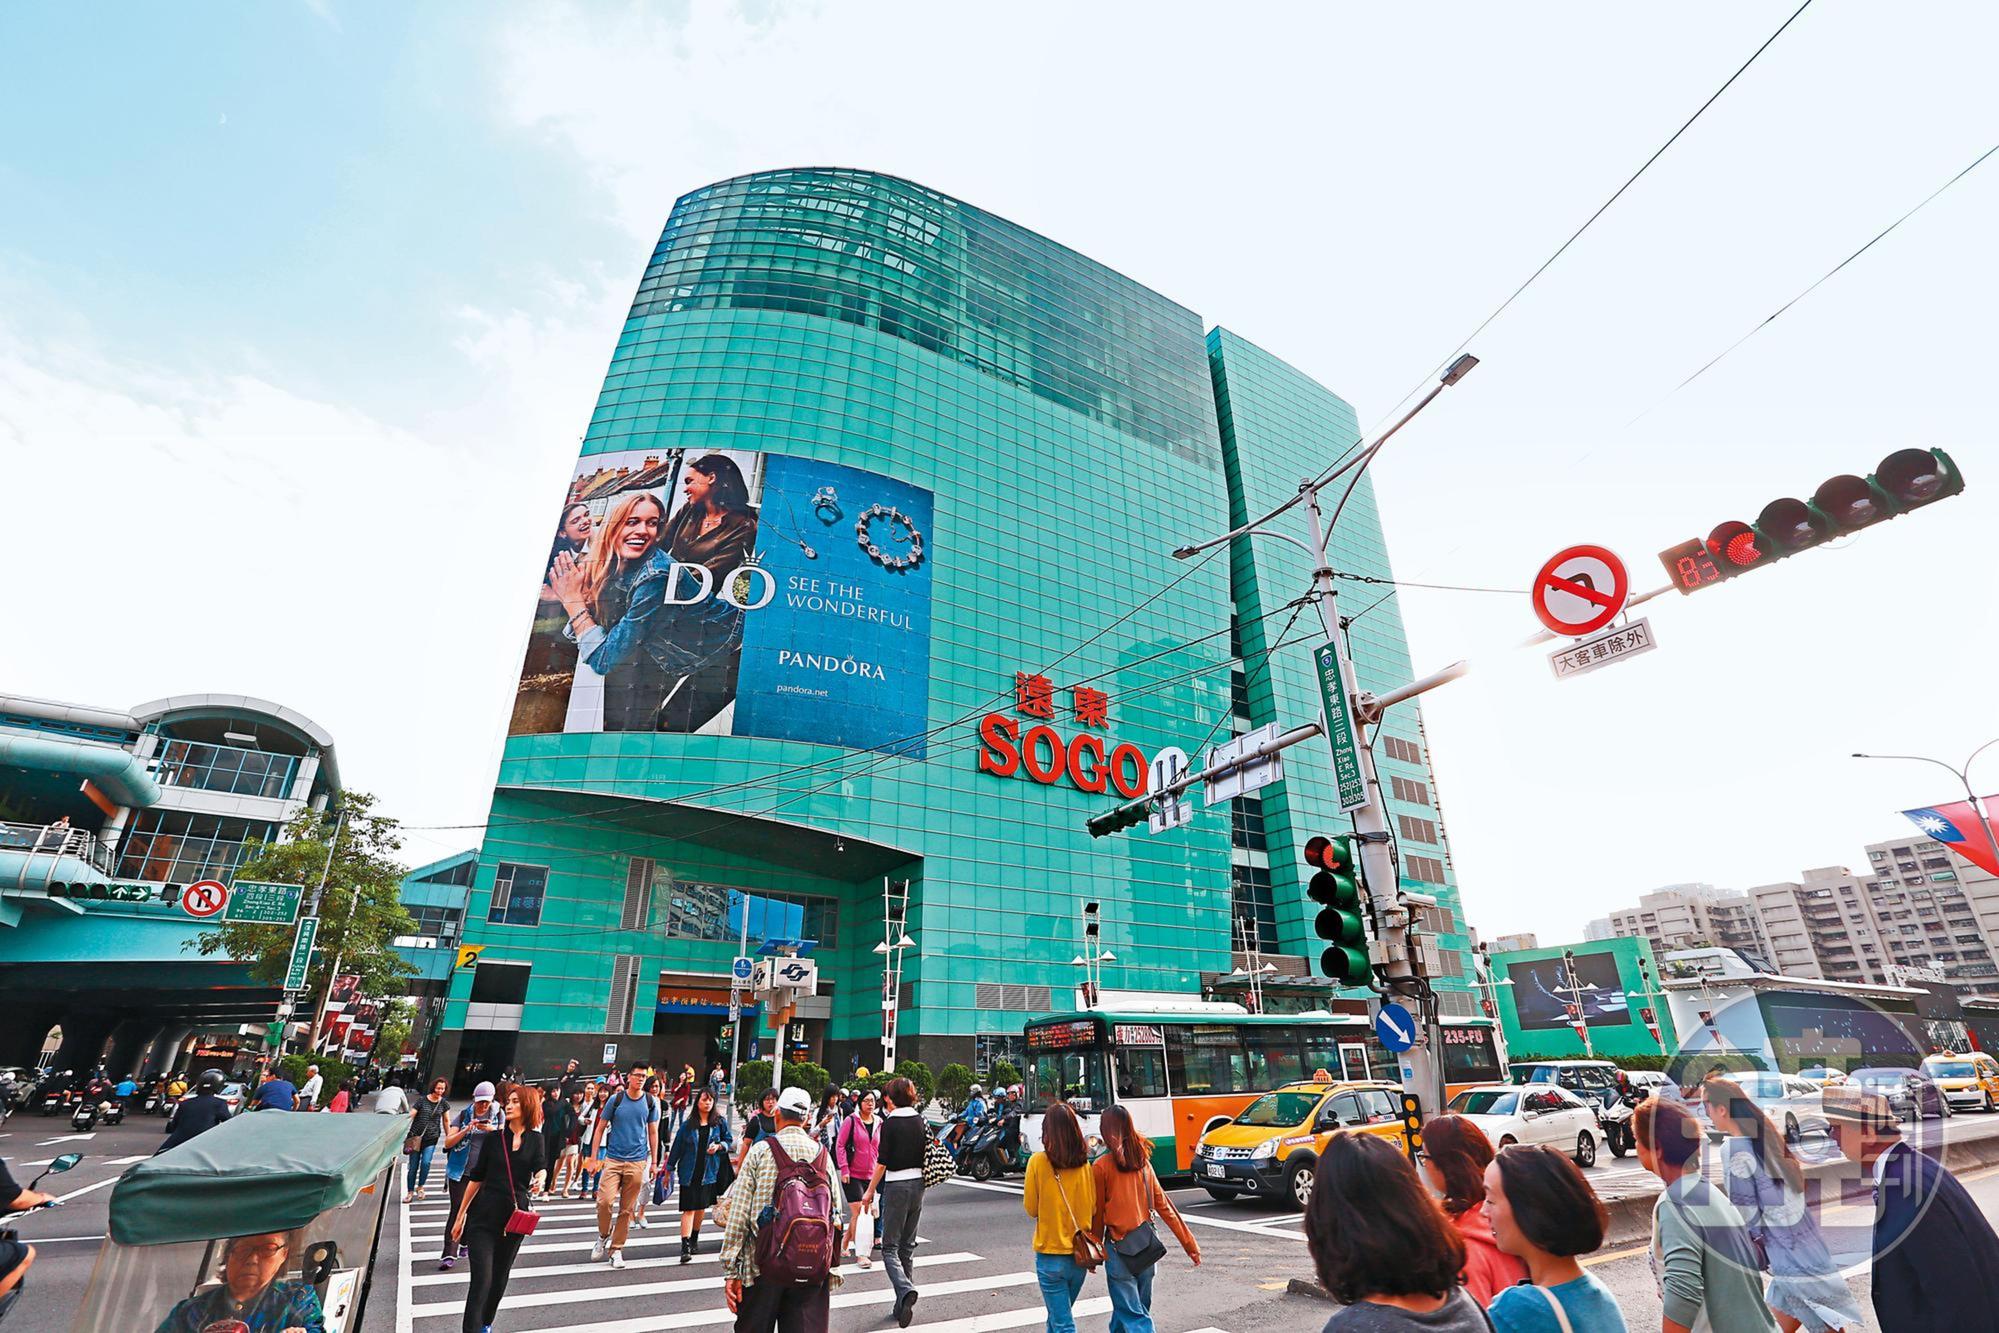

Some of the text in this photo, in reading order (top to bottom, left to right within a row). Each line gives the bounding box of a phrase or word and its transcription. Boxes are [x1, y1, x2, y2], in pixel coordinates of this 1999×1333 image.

[664, 561, 777, 611] DO
[788, 575, 864, 602] SEE THE
[786, 593, 913, 630] WONDERFUL
[778, 650, 887, 681] PANDORA
[1558, 629, 1645, 673] 大客車除外
[776, 684, 829, 698] pandora.net
[1014, 671, 1110, 729] 遠東
[1324, 668, 1348, 746] 忠孝東路三段
[979, 713, 1149, 799] SOGO
[1335, 746, 1353, 757] Zhong
[1337, 756, 1350, 765] Xiao
[247, 884, 286, 895] 忠孝東路
[462, 951, 478, 968] 2
